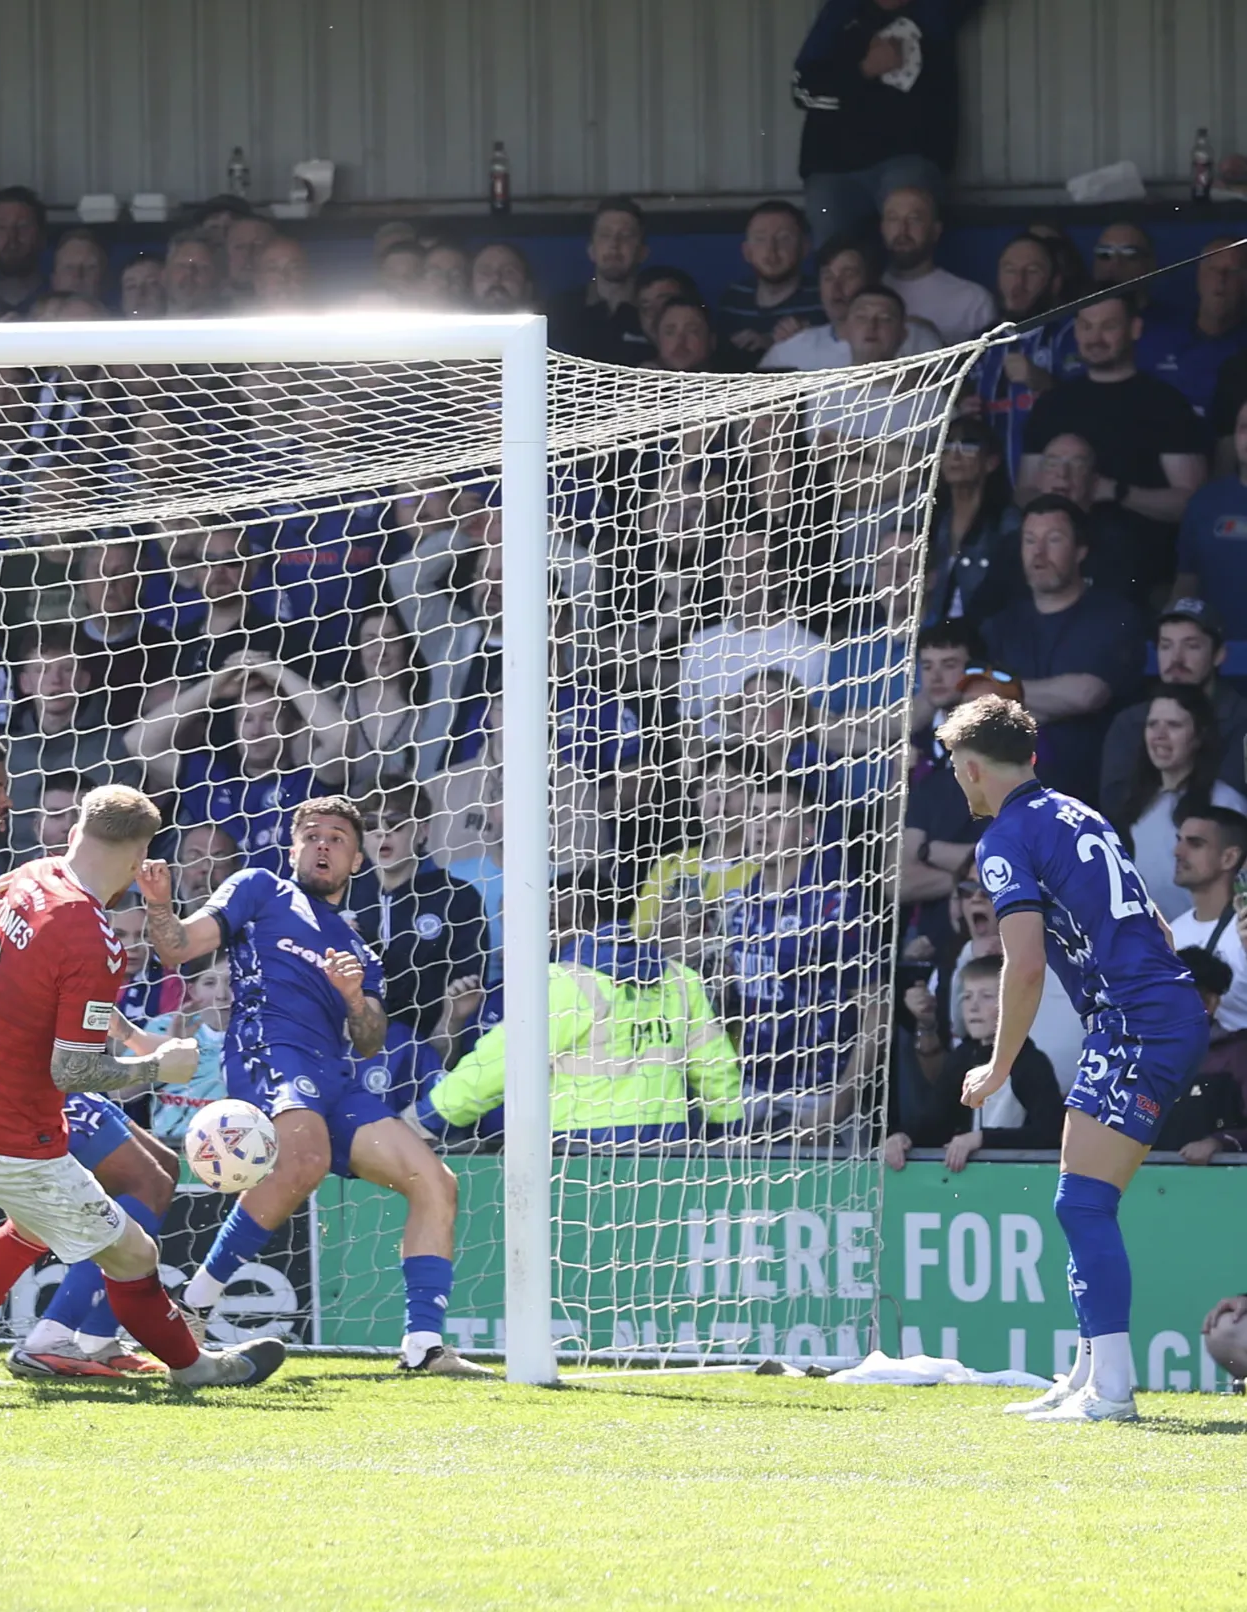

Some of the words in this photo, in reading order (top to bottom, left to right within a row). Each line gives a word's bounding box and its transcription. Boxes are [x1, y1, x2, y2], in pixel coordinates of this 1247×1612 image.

[277, 938, 329, 969] Crow
[687, 1208, 874, 1300] HERE
[904, 1211, 1045, 1303] FOR
